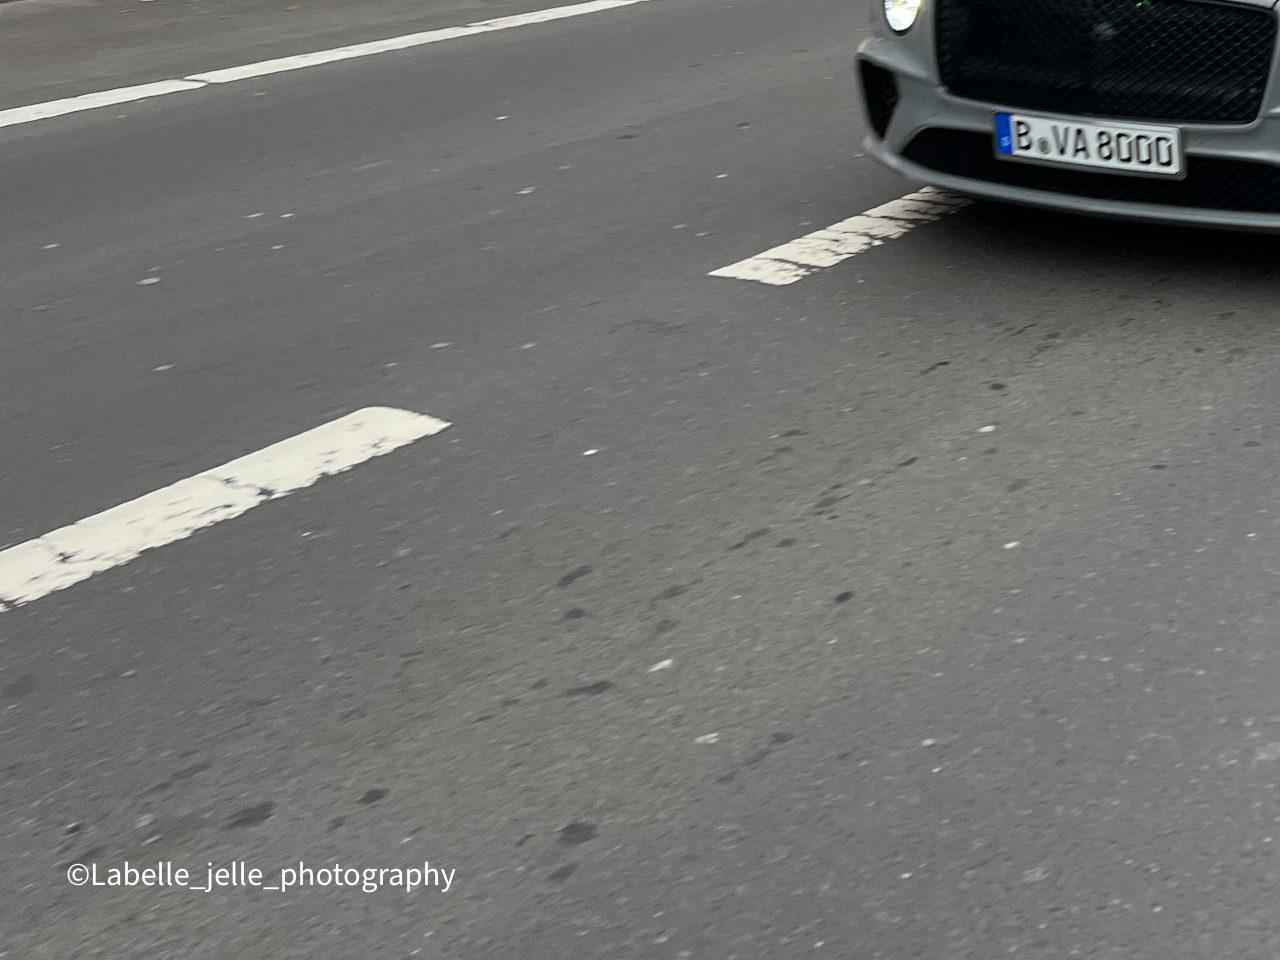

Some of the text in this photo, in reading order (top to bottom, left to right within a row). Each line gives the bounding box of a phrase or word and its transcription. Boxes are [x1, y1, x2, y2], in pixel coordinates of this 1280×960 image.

[1014, 120, 1173, 167] B VA 8000
